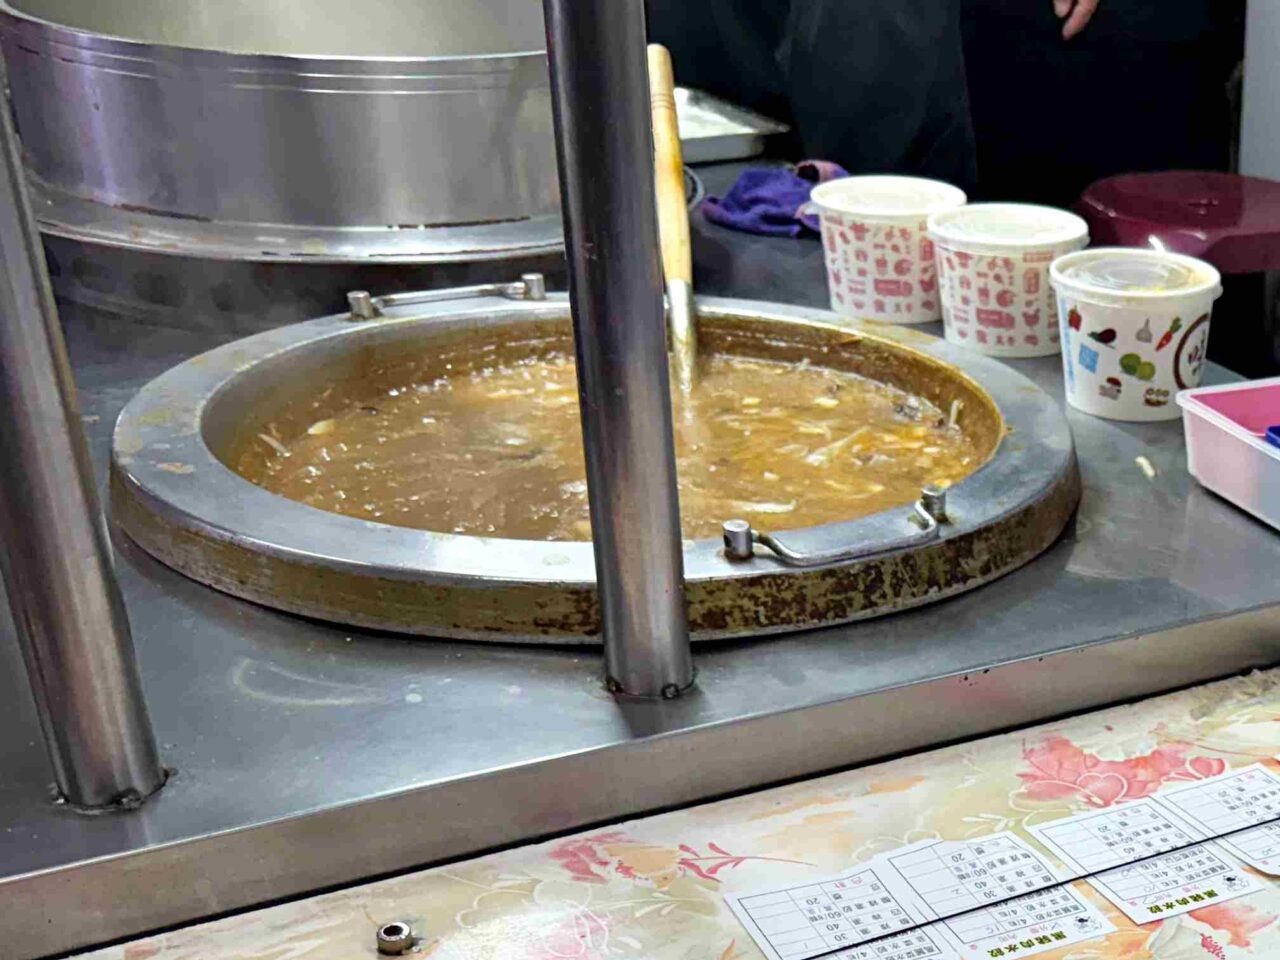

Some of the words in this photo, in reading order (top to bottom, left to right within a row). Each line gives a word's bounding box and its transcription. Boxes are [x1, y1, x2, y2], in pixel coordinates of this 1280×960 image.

[987, 931, 1066, 957] 黑豬肉水餃
